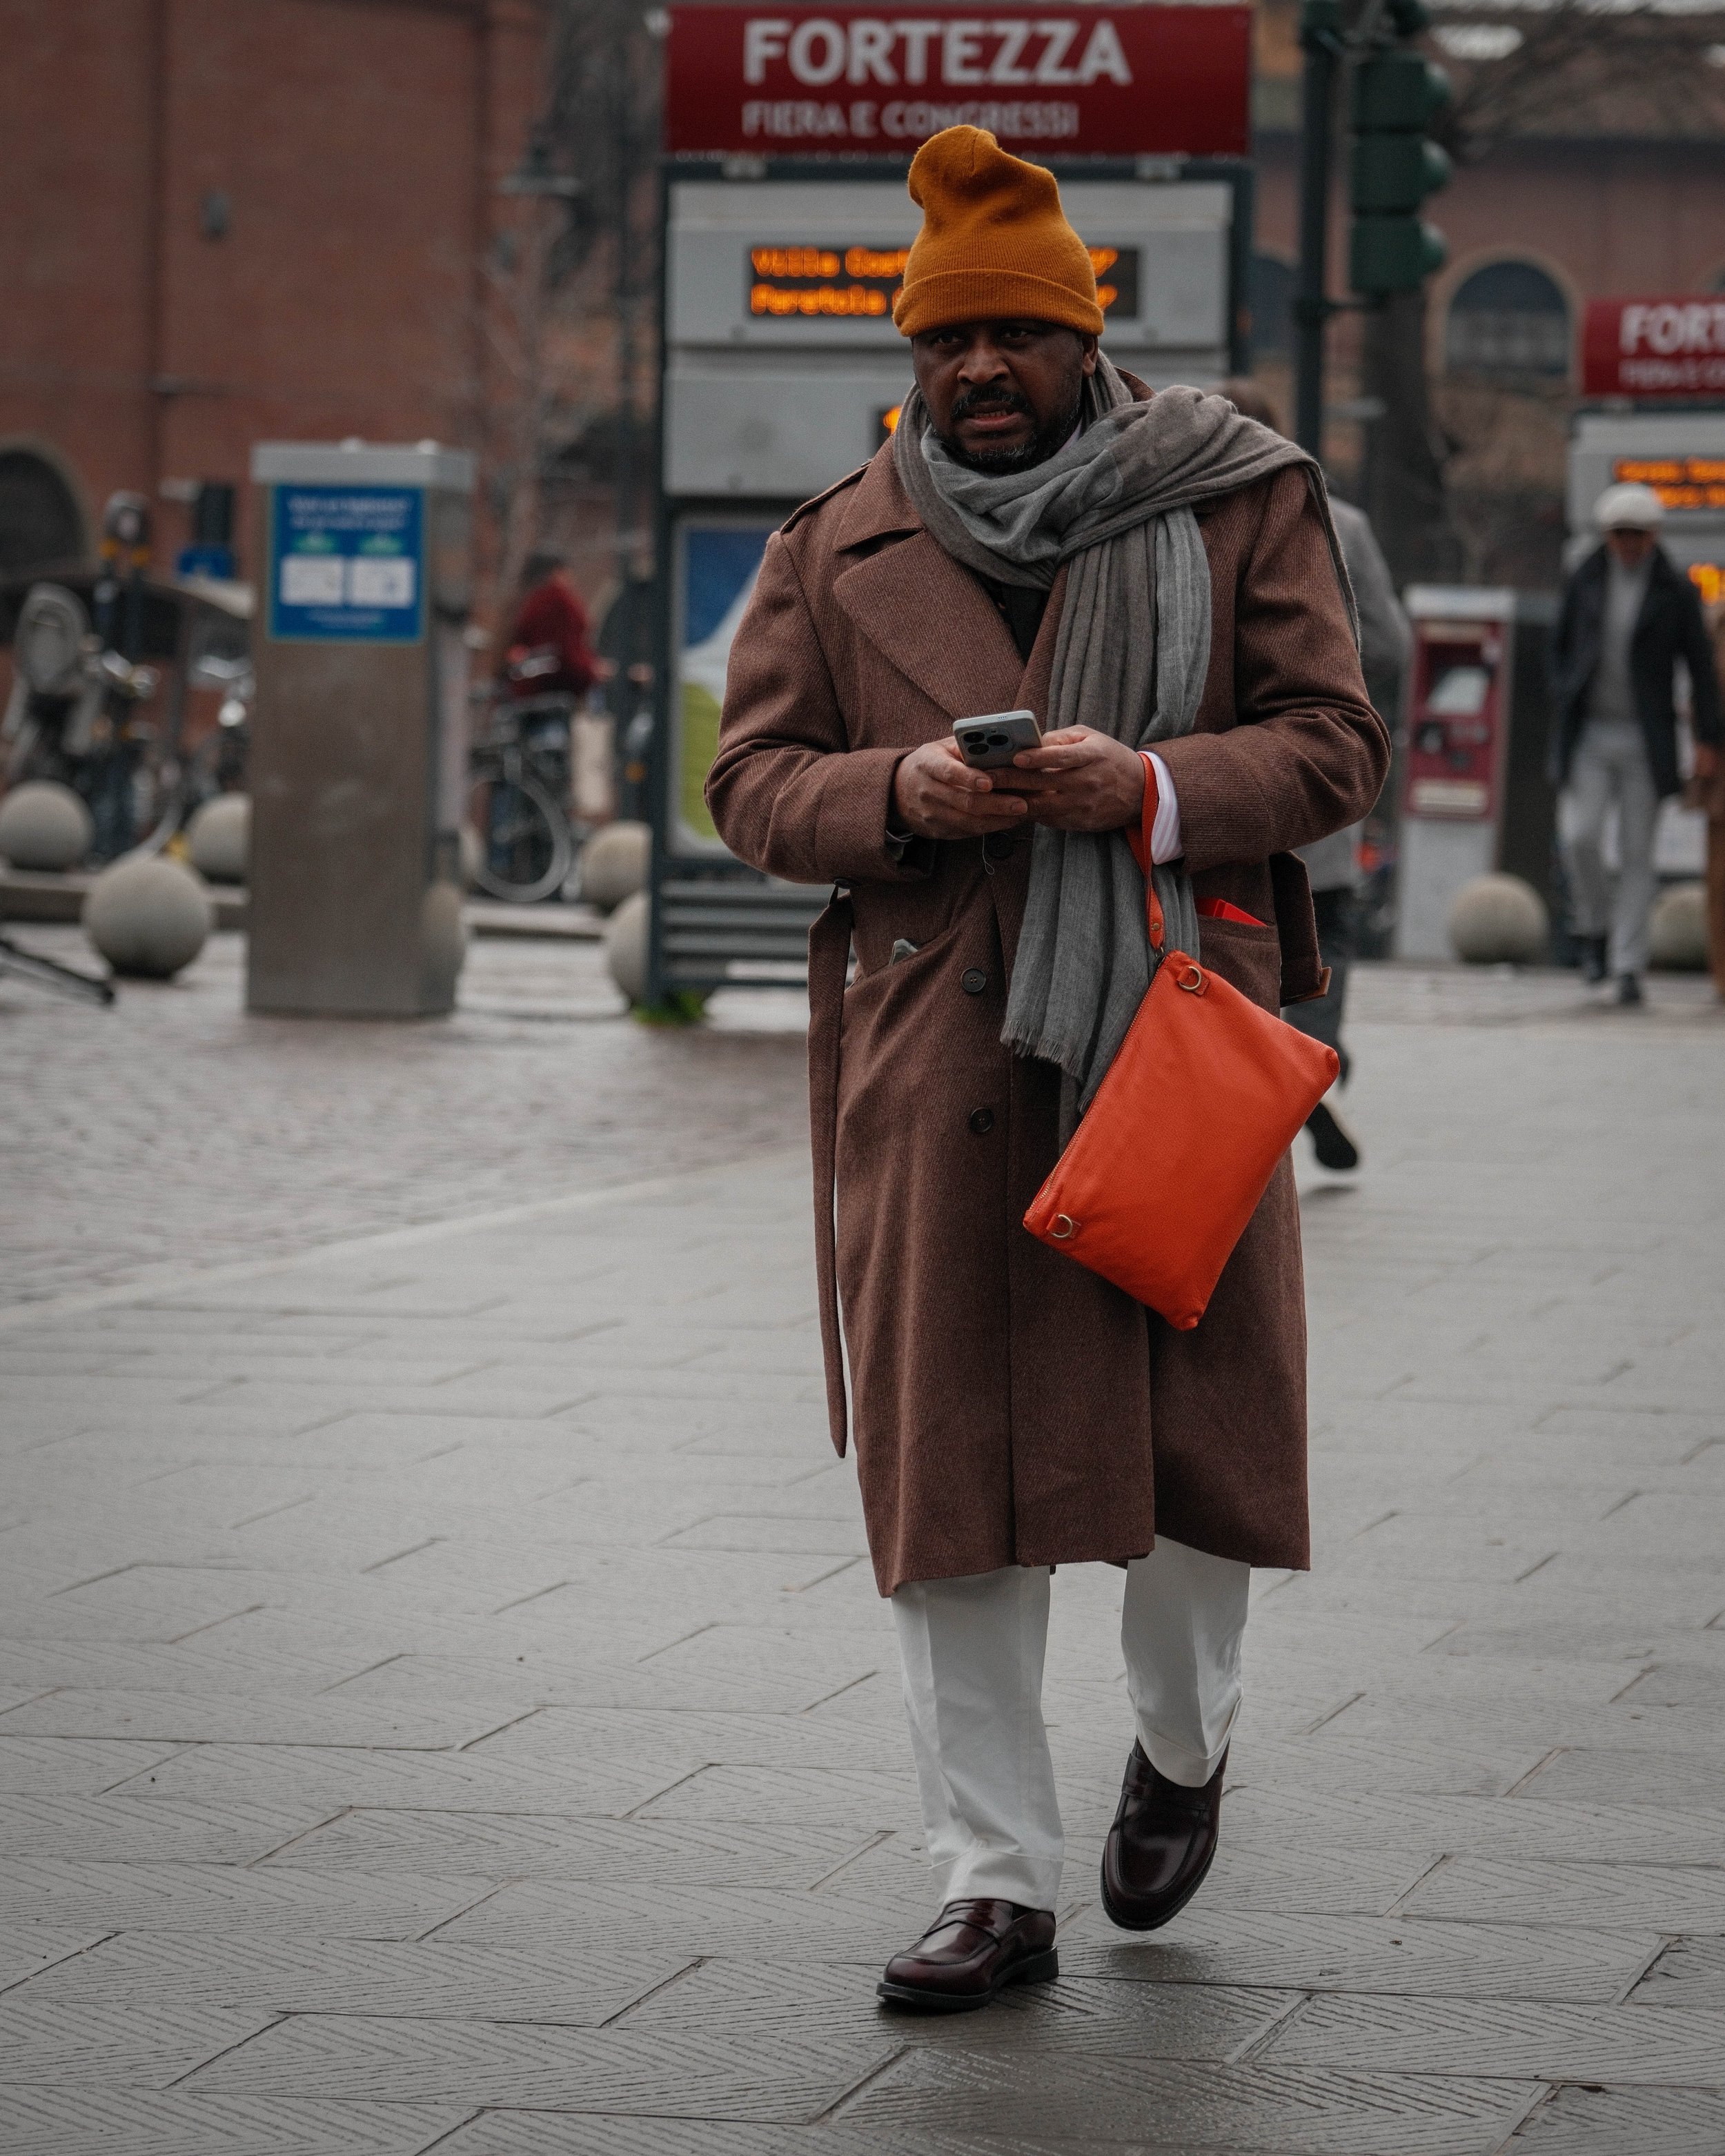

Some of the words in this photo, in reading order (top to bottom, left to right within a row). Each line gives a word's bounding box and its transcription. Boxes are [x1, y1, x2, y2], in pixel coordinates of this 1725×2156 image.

[743, 18, 1133, 86] FORTEZZA
[742, 101, 847, 137] FIERA
[849, 101, 876, 137] E
